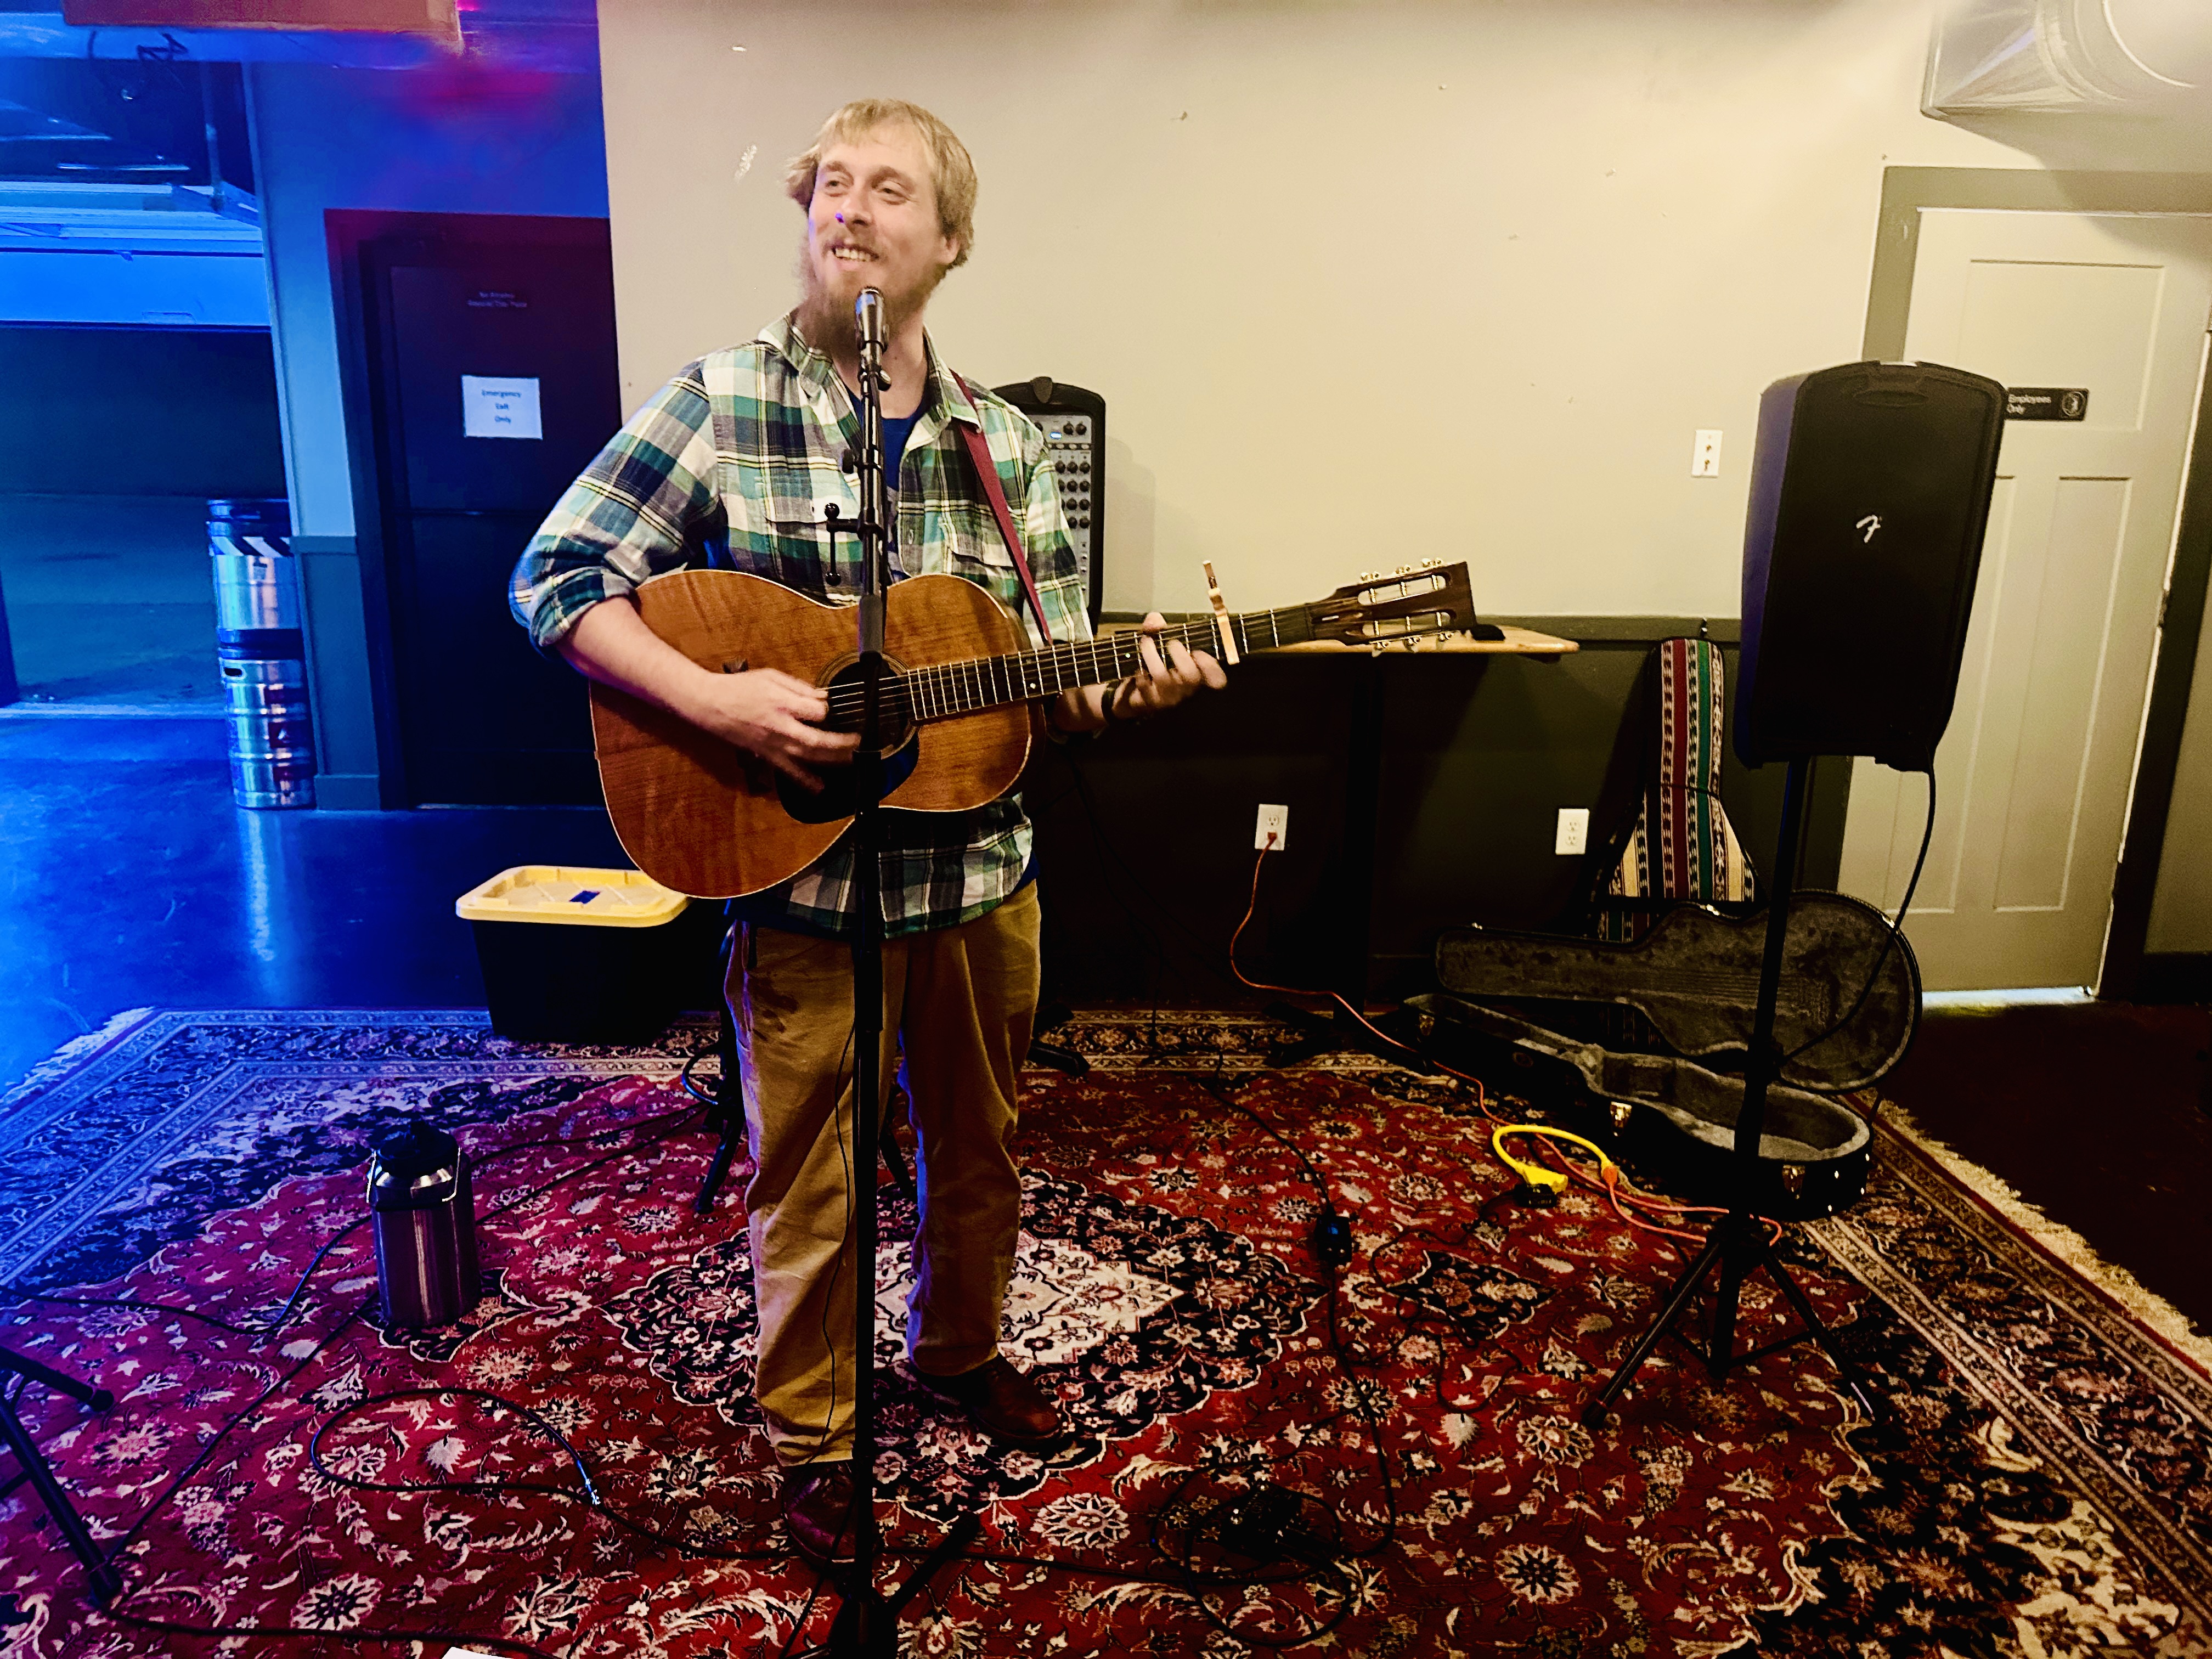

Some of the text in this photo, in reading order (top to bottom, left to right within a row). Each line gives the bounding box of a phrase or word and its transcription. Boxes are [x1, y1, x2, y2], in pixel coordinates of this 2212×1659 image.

[482, 390, 522, 398] Emergency
[2008, 393, 2052, 404] Employees
[494, 415, 511, 425] Only
